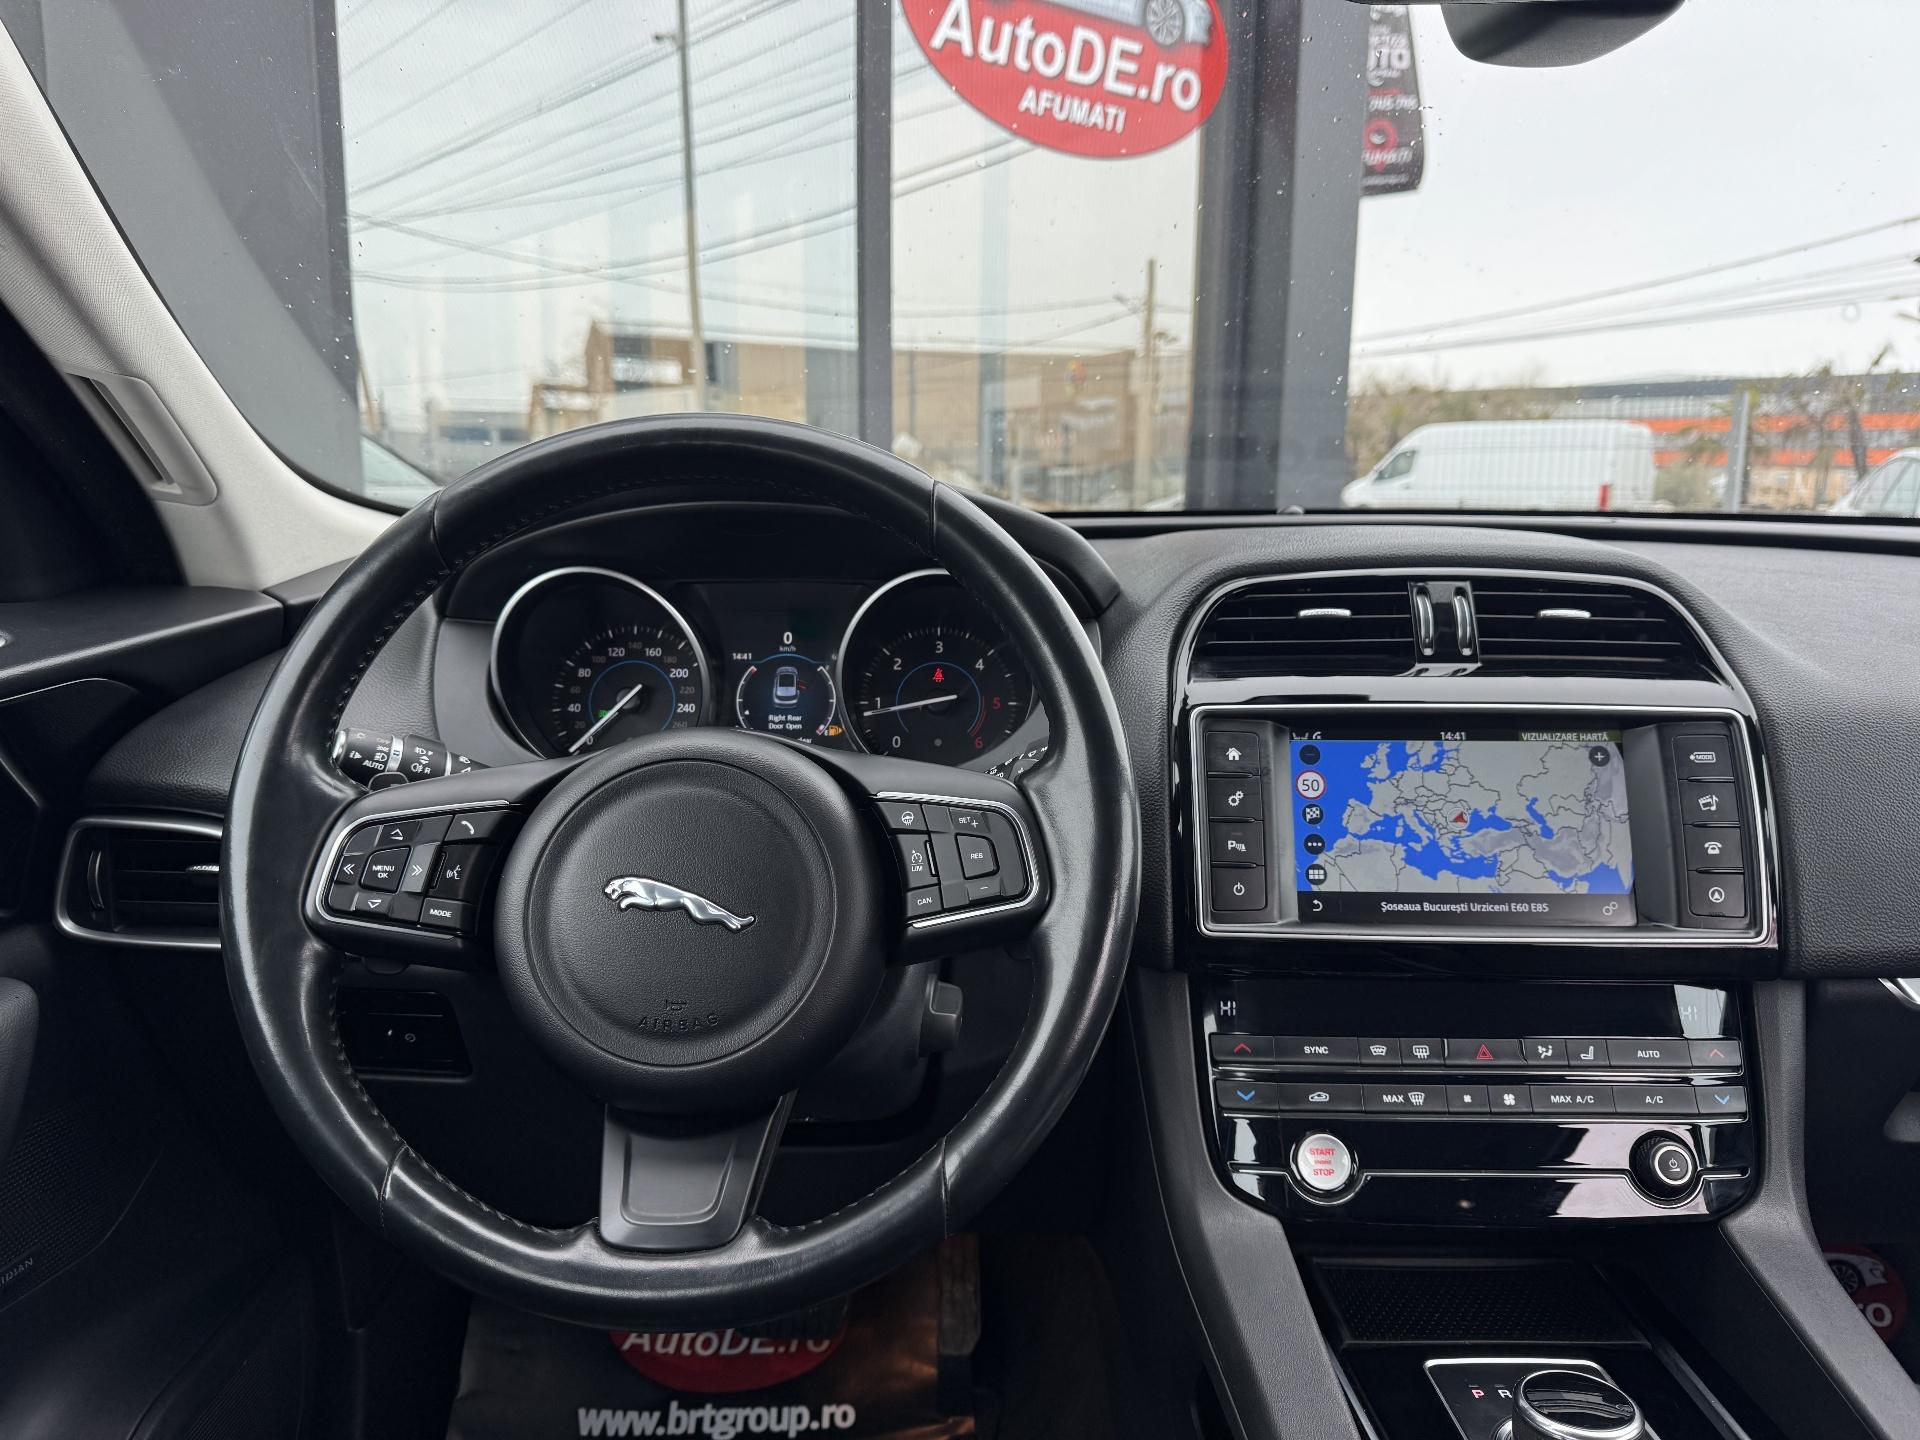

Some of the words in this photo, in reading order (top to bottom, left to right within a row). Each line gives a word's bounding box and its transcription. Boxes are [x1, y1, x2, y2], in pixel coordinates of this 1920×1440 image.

[929, 0, 1201, 112] AutoDE.ro
[1018, 87, 1127, 134] AFUMATI
[784, 632, 793, 644] 0
[935, 641, 943, 653] 3
[608, 648, 625, 657] 120
[645, 648, 662, 657] 160
[664, 656, 677, 664] 180
[893, 659, 902, 670] 2
[975, 658, 985, 670] 4
[577, 668, 591, 677] 80
[669, 669, 689, 678] 200
[567, 703, 581, 712] 40
[876, 697, 882, 708] 1
[993, 697, 1001, 709] 5
[676, 703, 696, 713] 240
[786, 723, 802, 731] Open
[1440, 731, 1466, 741] 14:41
[1521, 731, 1578, 741] VIZUALIZARE
[1579, 730, 1609, 741] HARTĂ
[586, 736, 594, 746] 0
[892, 736, 901, 748] 0
[975, 736, 983, 748] 6
[362, 759, 385, 771] AUTO
[1301, 779, 1320, 792] 50
[377, 871, 389, 879] OK
[1470, 902, 1509, 912] Urziceni
[1511, 903, 1529, 912] E60
[1531, 903, 1549, 912] E85
[429, 908, 452, 917] MODE
[1220, 1001, 1236, 1016] HI
[1680, 1006, 1697, 1021] HI
[638, 1012, 719, 1033] AIRBAG
[1304, 1045, 1329, 1055] SYNC
[1637, 1050, 1660, 1058] AUTO
[1383, 1094, 1404, 1103] MAX
[1551, 1095, 1572, 1103] MAX
[1576, 1095, 1594, 1104] A/C
[1645, 1095, 1664, 1104] A/C
[1310, 1148, 1335, 1156] START
[1313, 1168, 1335, 1176] STOP
[0, 1257, 33, 1288] IDIAN
[1472, 1389, 1484, 1399] P
[1498, 1389, 1512, 1398] R
[577, 1400, 856, 1440] www.brtgroup.ro
